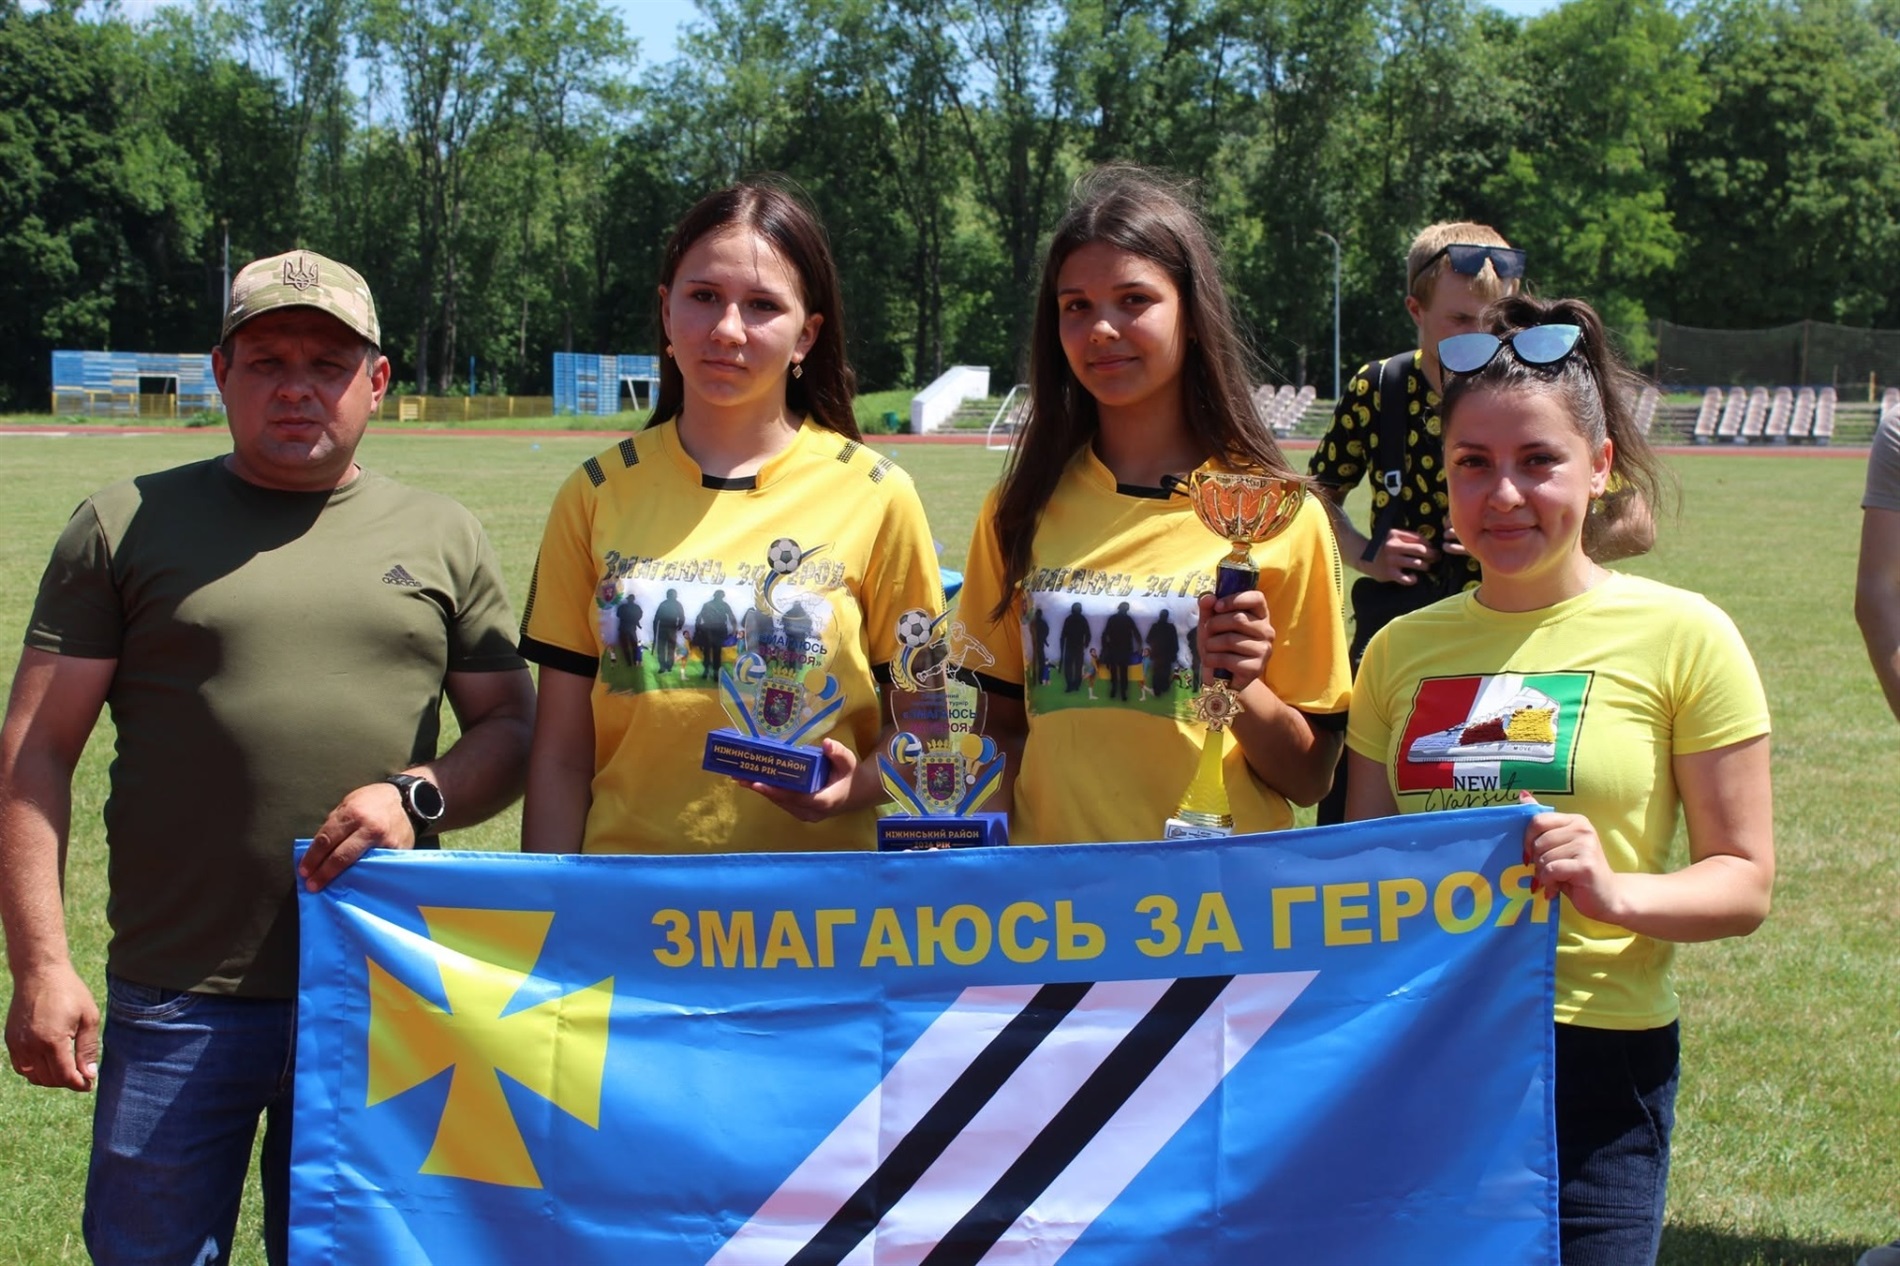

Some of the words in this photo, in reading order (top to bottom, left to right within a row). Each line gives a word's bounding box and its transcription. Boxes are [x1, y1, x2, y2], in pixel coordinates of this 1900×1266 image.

[787, 558, 846, 588] ЕРОЯ
[713, 745, 774, 764] НІЖИНСЬКИЙ
[776, 758, 807, 772] РАЙОН
[740, 761, 760, 772] 2026
[761, 766, 777, 775] РІК
[1453, 776, 1499, 792] NEW
[885, 829, 947, 839] НІЖИНСЬКИЙ
[948, 829, 980, 839] РАЙОН
[651, 900, 1106, 968] ЗМАГАЮСЬ
[1135, 892, 1243, 958] ЗА
[1271, 863, 1549, 950] ГЕРОЯ
